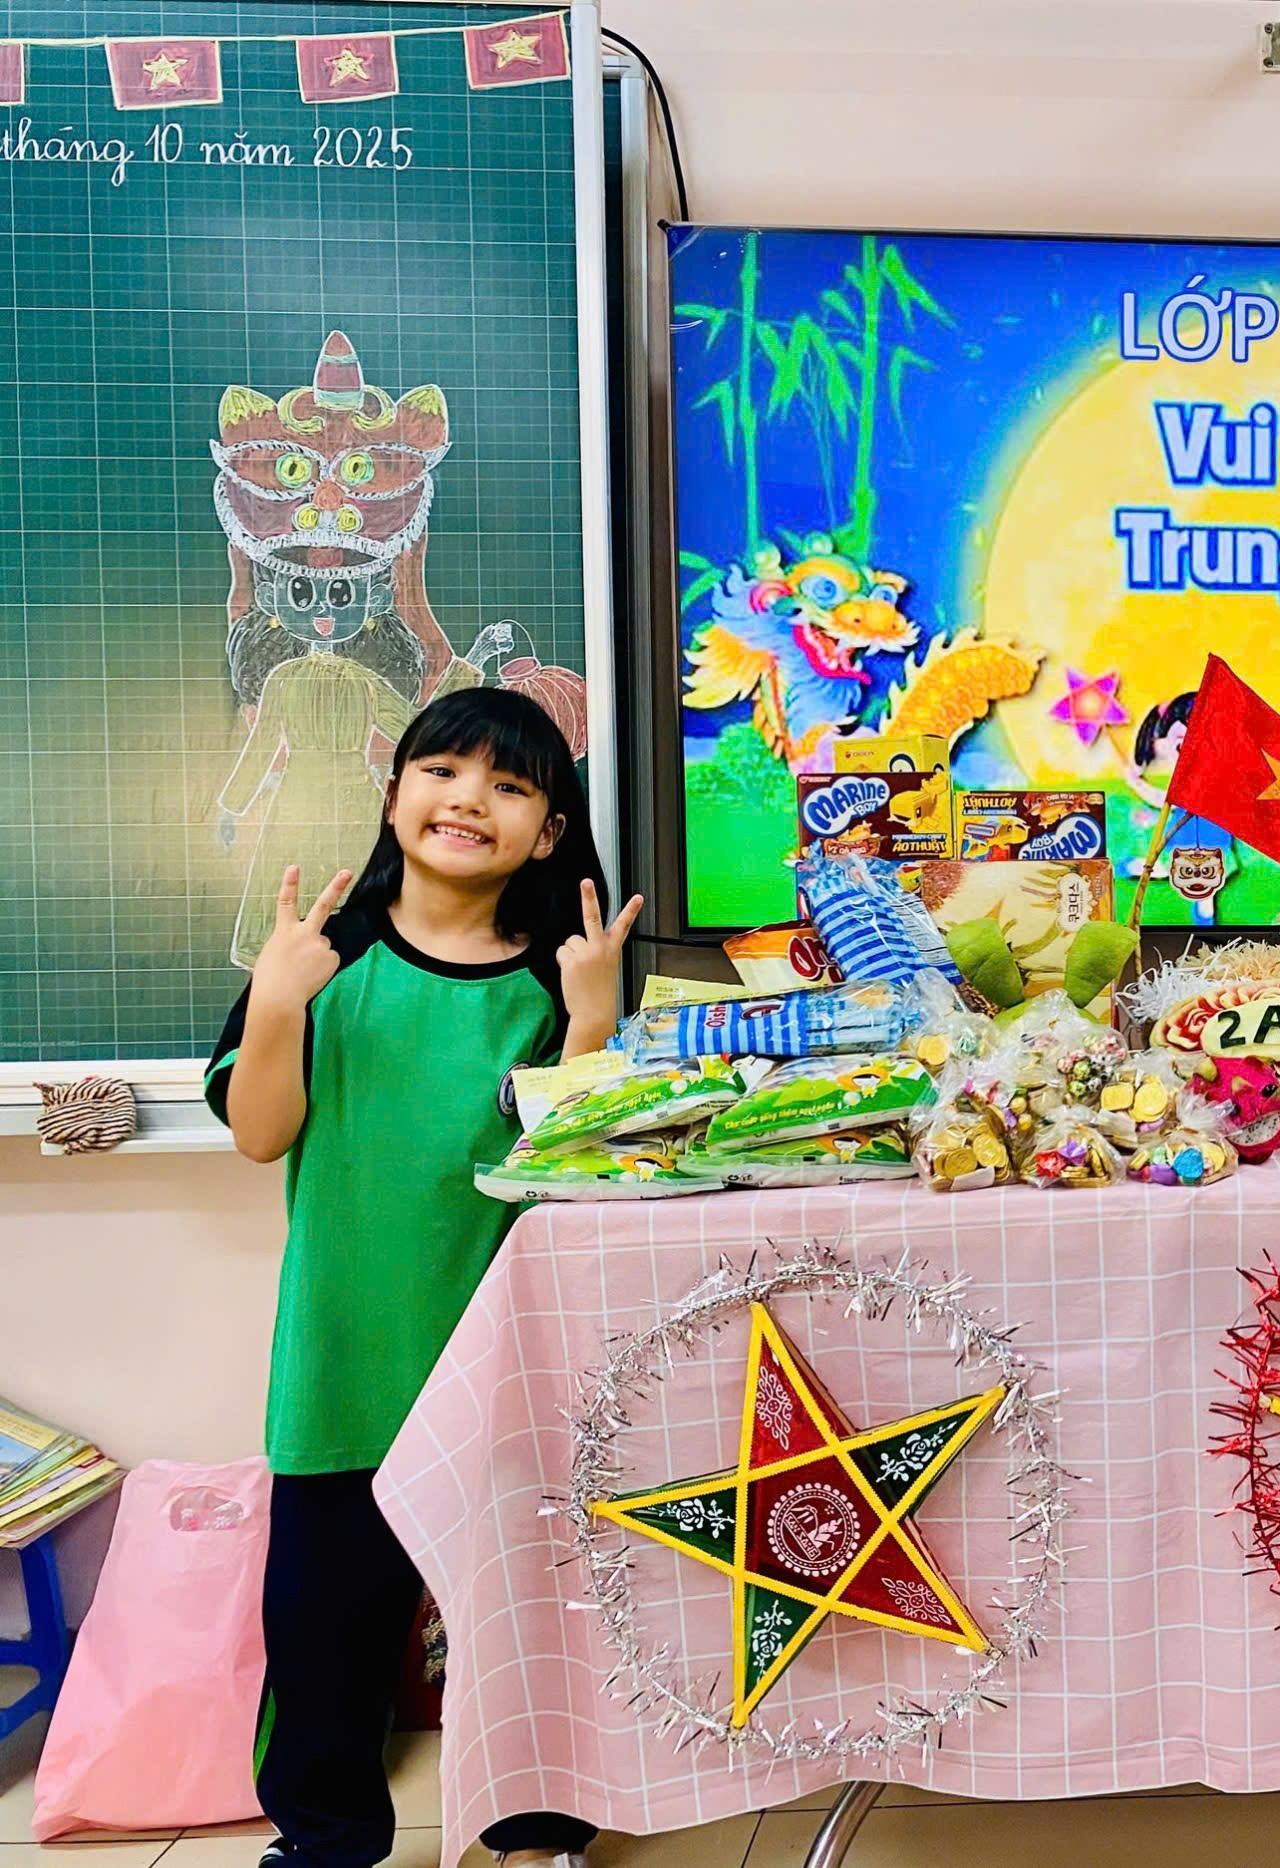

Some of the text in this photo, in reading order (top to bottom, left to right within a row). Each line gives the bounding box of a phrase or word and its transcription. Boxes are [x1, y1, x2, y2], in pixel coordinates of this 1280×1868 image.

[0, 117, 413, 186] tháng 10 năm 2025
[1119, 274, 1280, 363] LỚP
[1155, 401, 1277, 485] Vui
[854, 801, 878, 816] BOY
[706, 1004, 726, 1028] Oish
